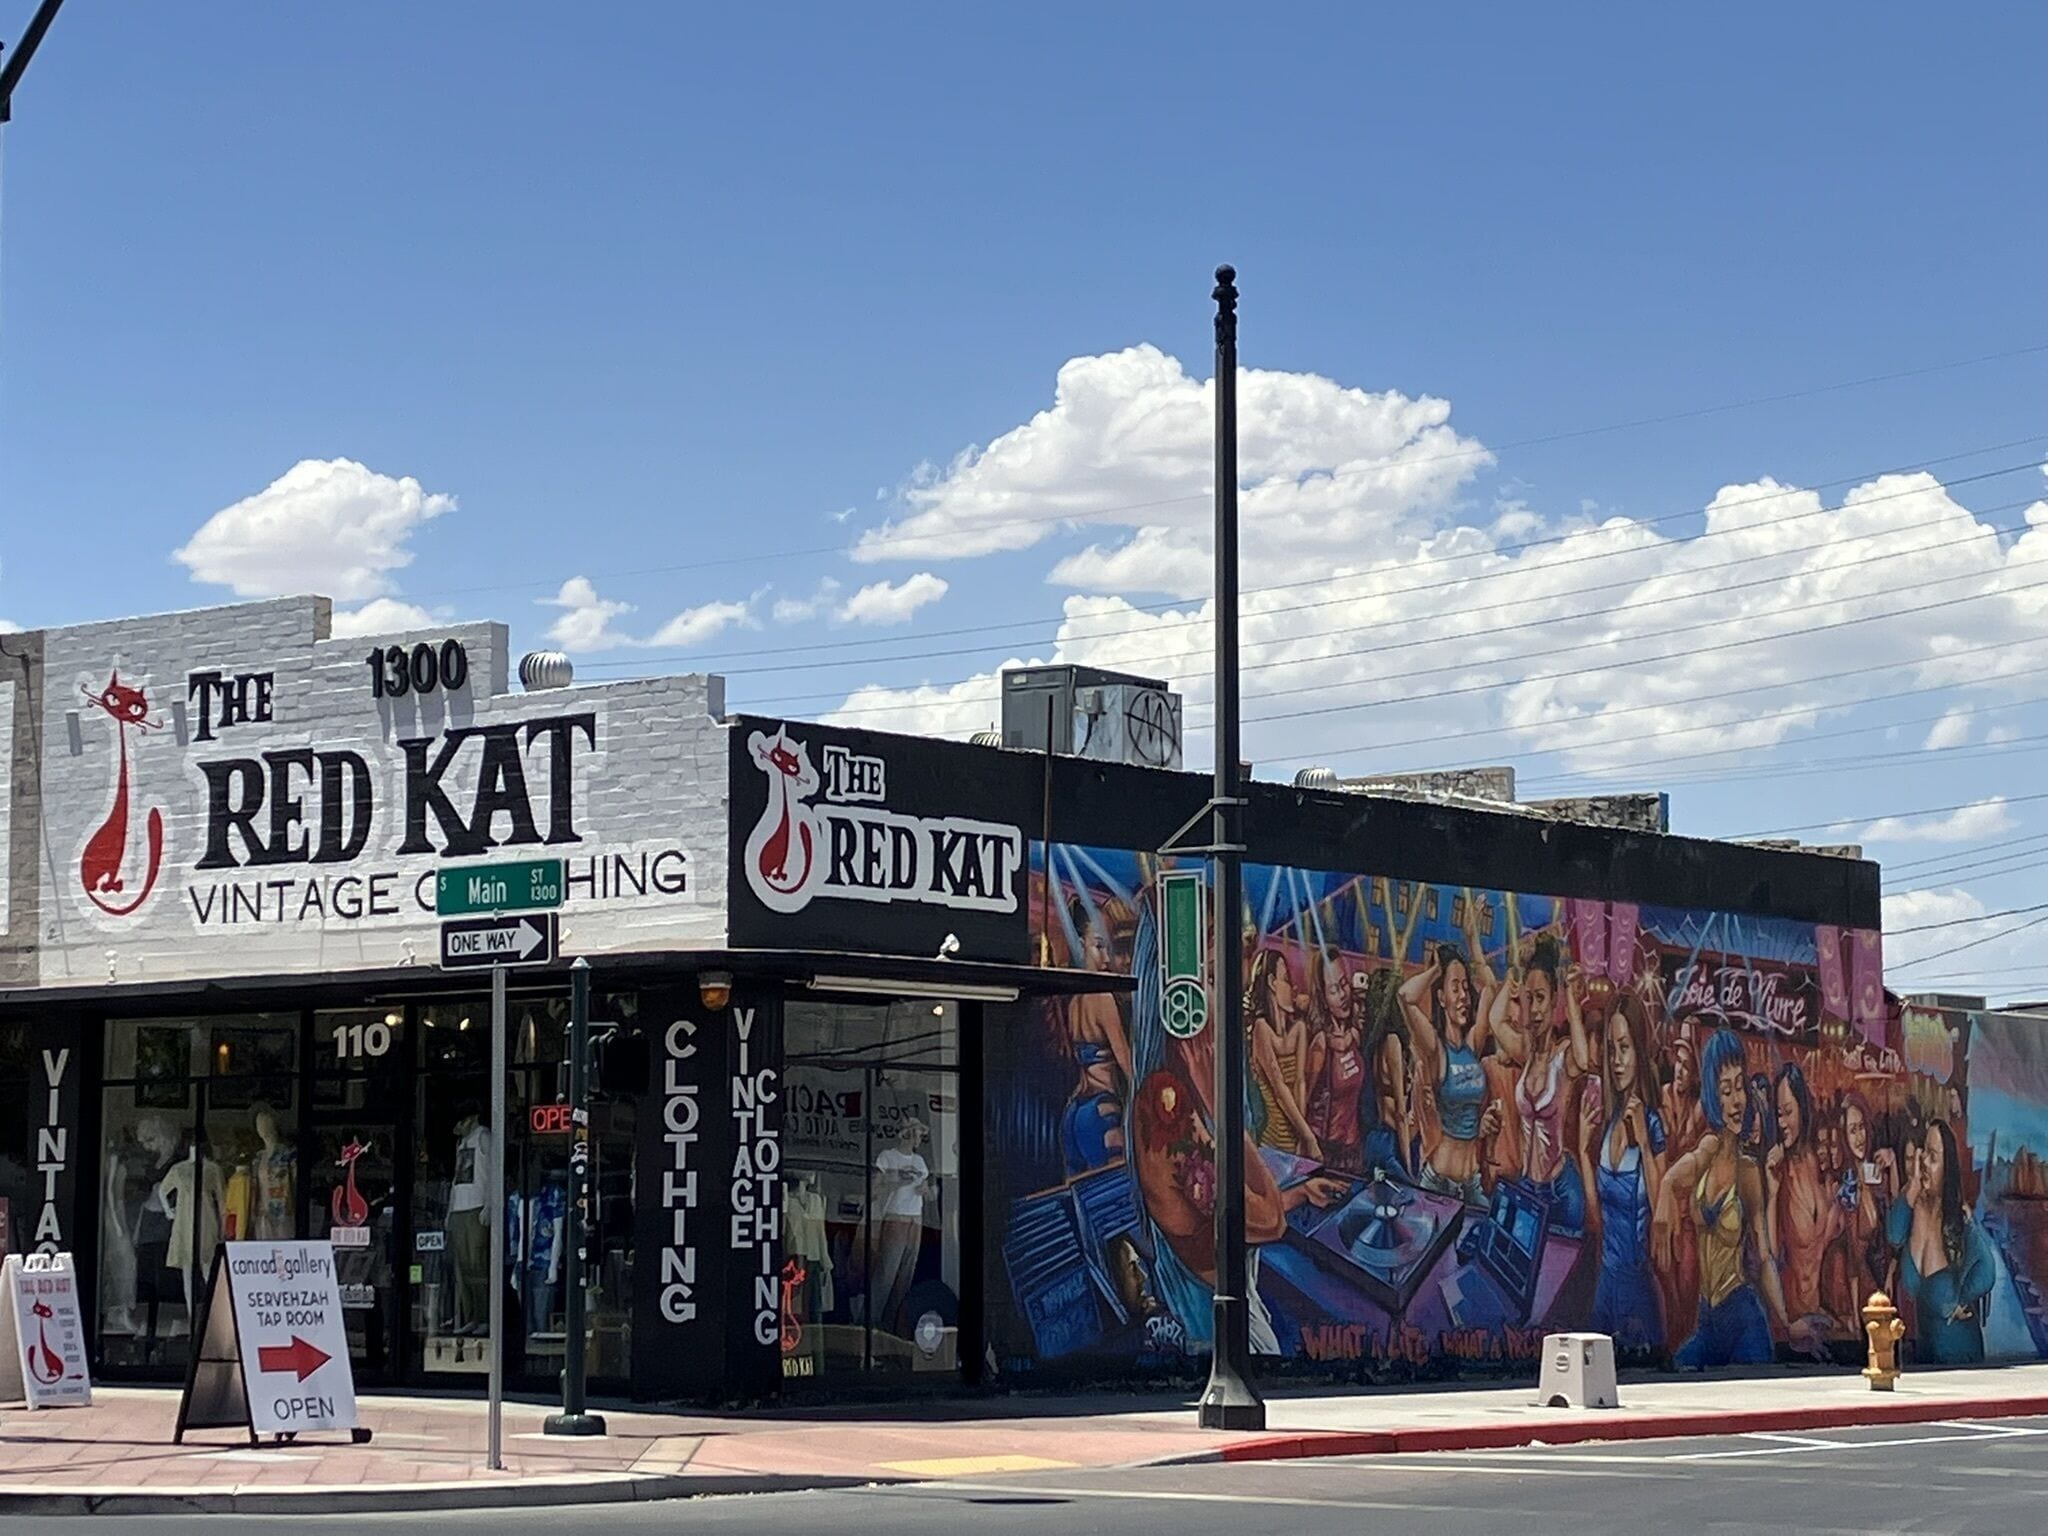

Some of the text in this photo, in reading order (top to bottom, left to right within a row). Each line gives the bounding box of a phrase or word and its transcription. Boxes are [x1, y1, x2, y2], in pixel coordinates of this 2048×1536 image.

[366, 638, 468, 698] 1300
[188, 671, 274, 742] THE
[194, 712, 596, 870] RED KAT
[824, 751, 883, 797] THE
[824, 816, 1015, 901] RED KAT
[188, 849, 687, 925] VINTAGE CHING
[440, 867, 544, 905] S Main ST
[530, 884, 557, 901] 1300
[451, 930, 517, 953] ONE WAY
[333, 1022, 391, 1057] 110
[532, 1108, 572, 1130] OPE
[731, 1008, 755, 1248] VINTAGE
[35, 1049, 70, 1255] VINTA
[660, 1020, 699, 1323] CLOTHING
[755, 1069, 780, 1345] CLOTHING
[232, 1249, 331, 1279] conrad gallery
[248, 1291, 329, 1308] SERVEHZAH
[257, 1310, 324, 1327] TAP ROOM
[274, 1397, 334, 1420] OPEN
